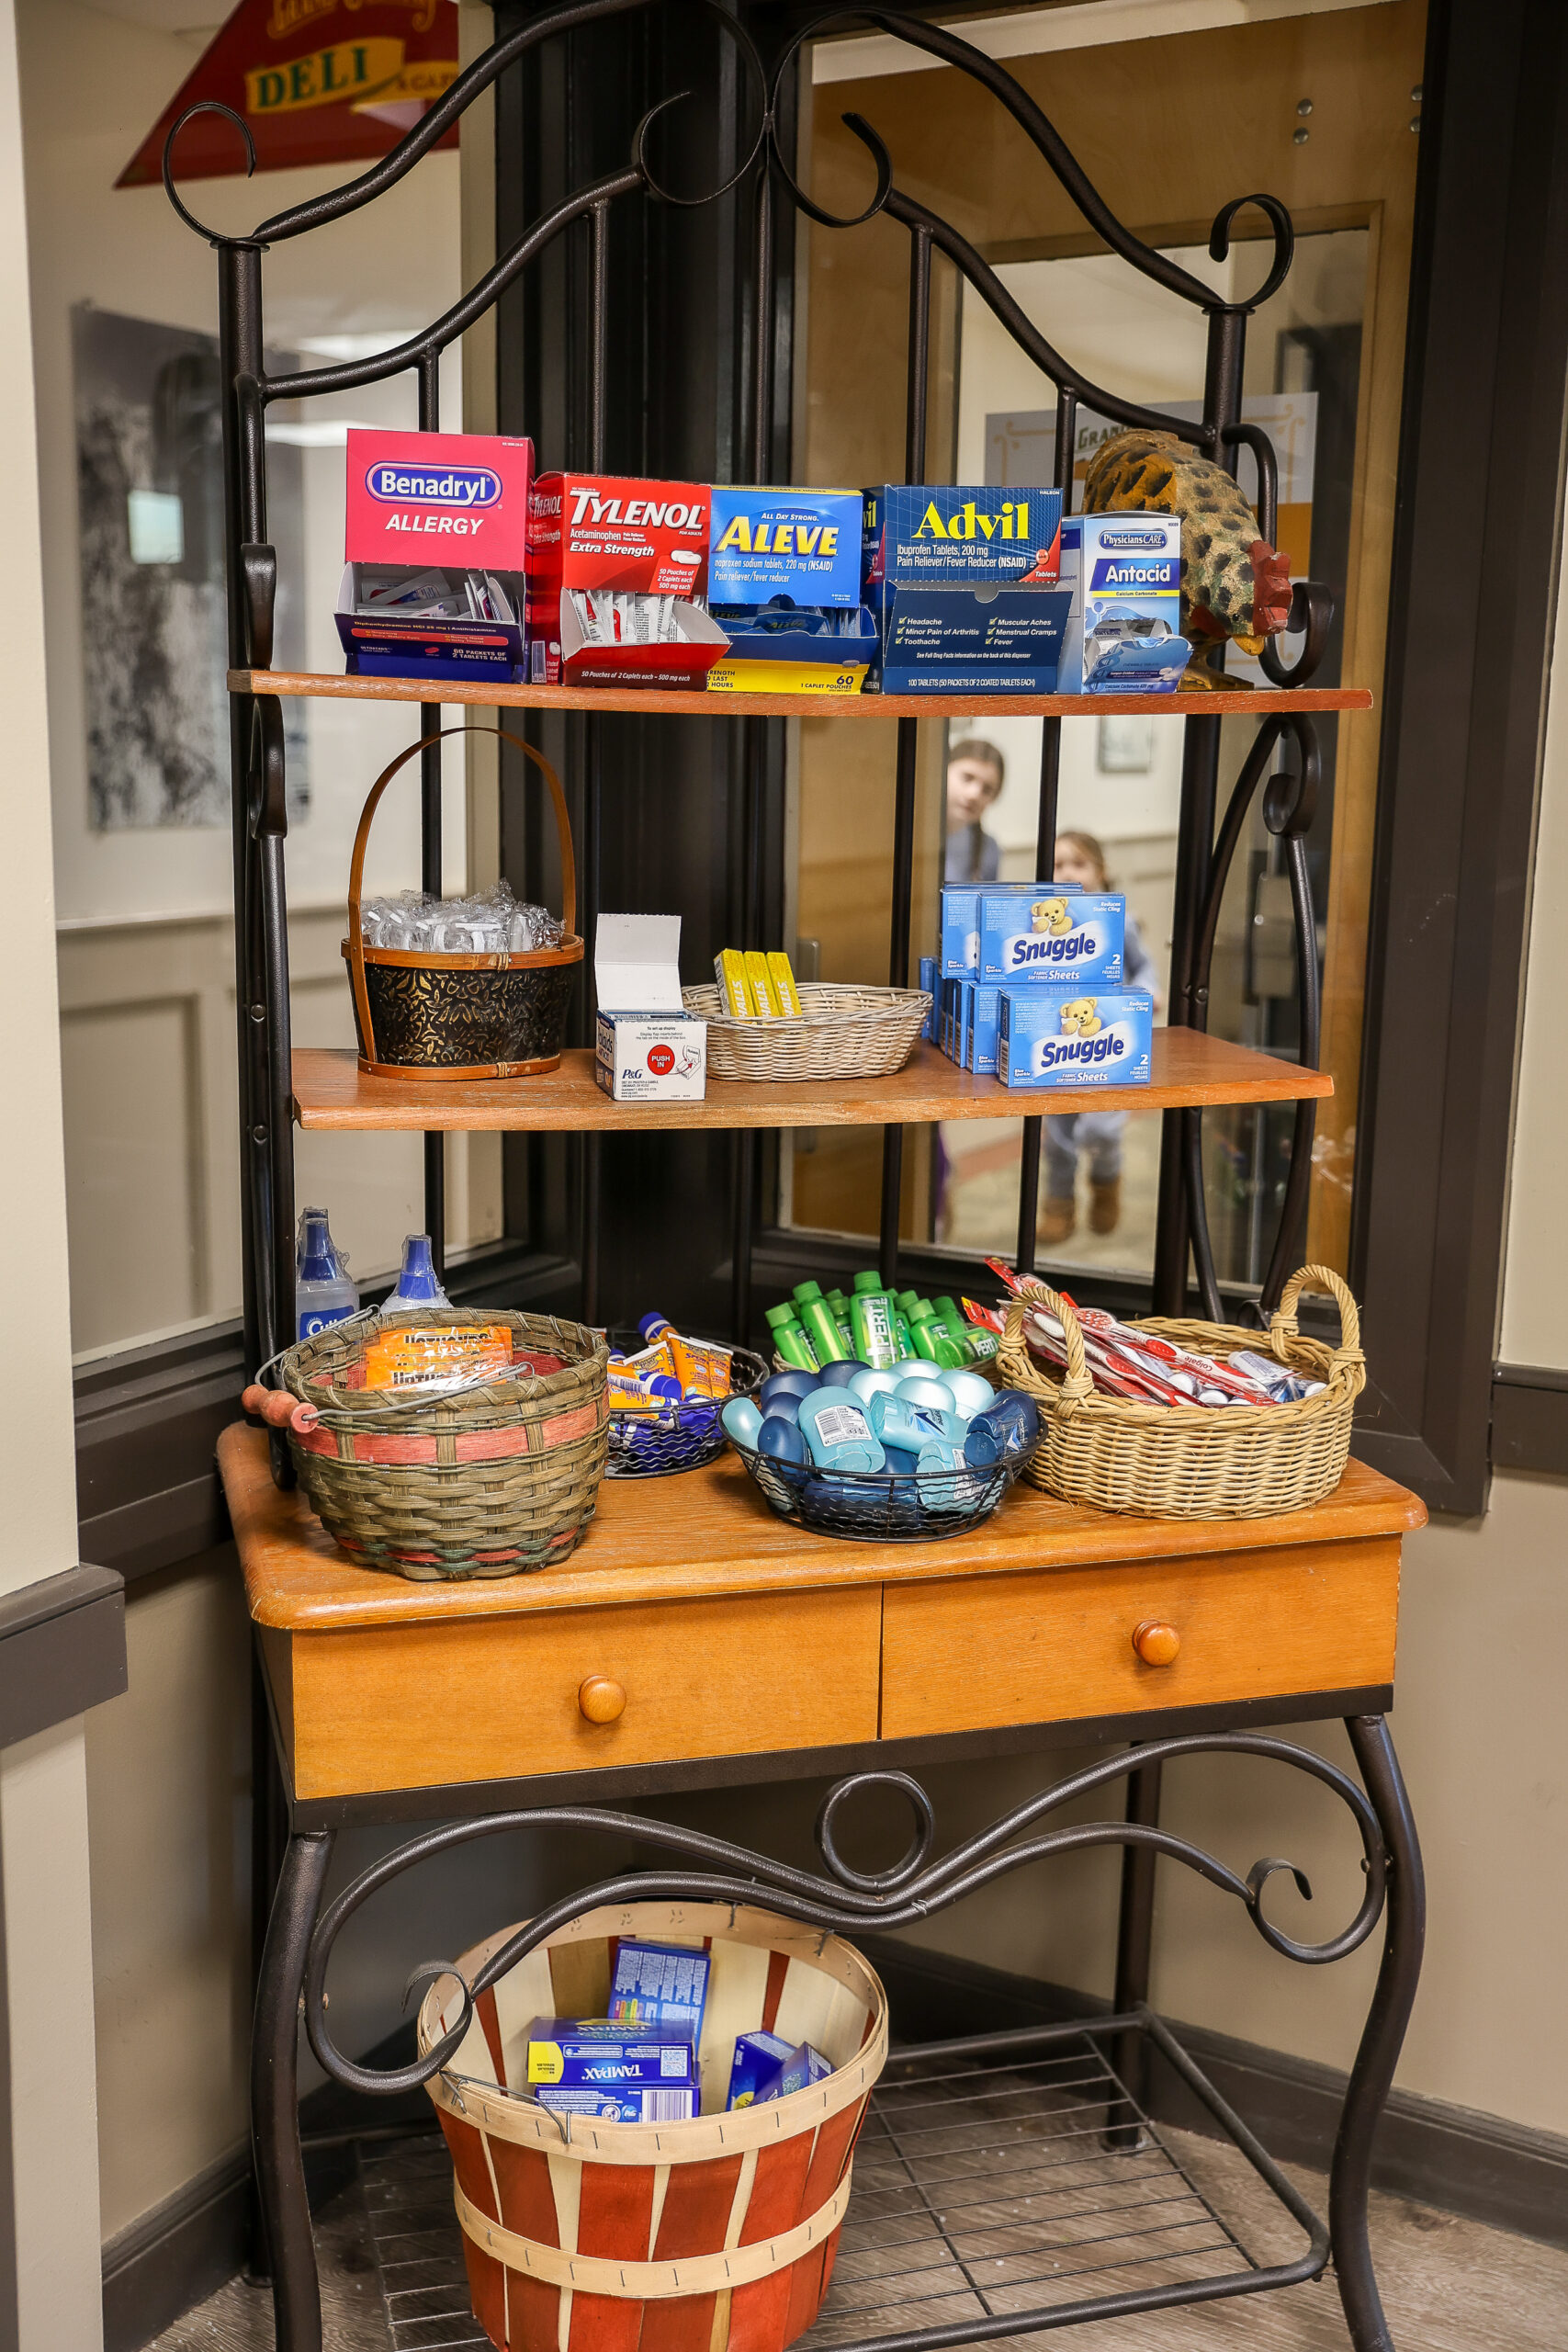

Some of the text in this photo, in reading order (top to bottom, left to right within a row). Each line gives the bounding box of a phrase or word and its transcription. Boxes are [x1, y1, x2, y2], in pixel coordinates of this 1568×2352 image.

[258, 48, 367, 107] DELI
[381, 470, 486, 504] Benadryl
[570, 490, 703, 530] TYLENOL
[863, 500, 877, 528] vil
[385, 514, 483, 535] ALLERGY
[911, 501, 1030, 541] Advil
[570, 528, 622, 542] Acetaminophen
[712, 516, 839, 556] ALEVE
[570, 542, 655, 558] Extra Strength
[897, 545, 988, 557] Ibuprofen Tablets, 200 mg
[715, 558, 833, 572] naproxen sodium tablets, 220 mg (NSAID)
[897, 556, 1027, 569] Pain Reliever/Fever Reducer (NSAID)
[714, 571, 790, 583] Pain reliever/fever reducer
[1105, 564, 1170, 582] Antacid
[836, 675, 854, 685] 60
[939, 678, 947, 687] (50
[1021, 679, 1036, 687] EACH)
[1012, 933, 1096, 964] Snuggle
[1112, 954, 1121, 965] 2
[1048, 970, 1080, 980] Sheets
[1041, 1033, 1124, 1067] Snuggle
[1140, 1054, 1148, 1065] 2
[622, 1069, 643, 1079] P&G
[1077, 1072, 1108, 1082] Sheets
[874, 1308, 889, 1346] PERT
[974, 1338, 995, 1357] PERT
[1185, 1356, 1213, 1372] Colgate
[585, 2064, 643, 2081] TAMPAX
